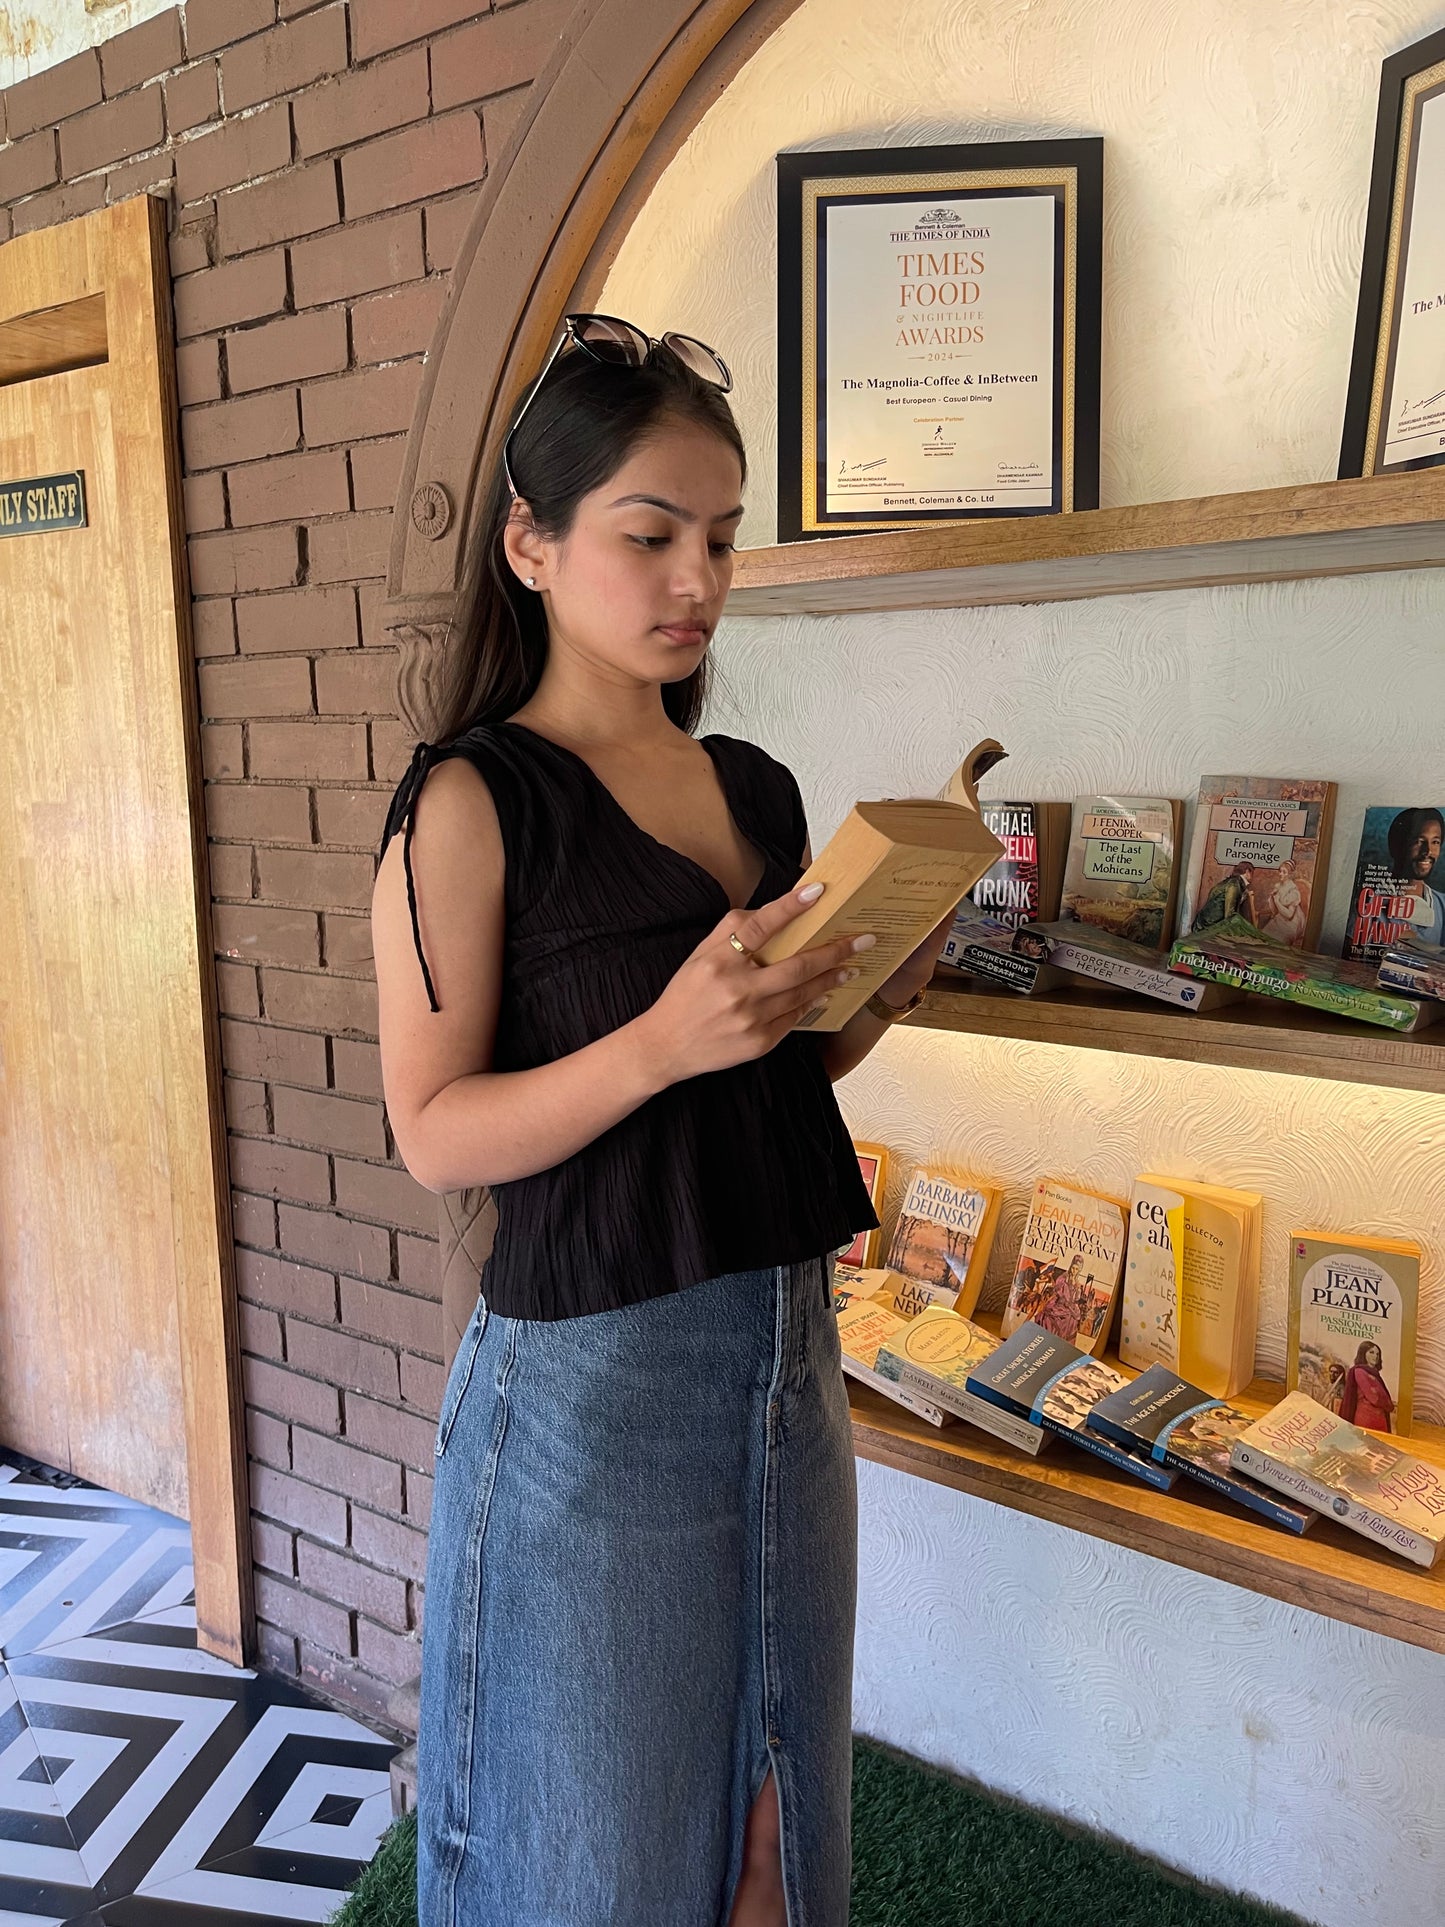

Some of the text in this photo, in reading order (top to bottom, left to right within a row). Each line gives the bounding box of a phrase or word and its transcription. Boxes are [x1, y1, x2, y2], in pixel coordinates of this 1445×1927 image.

[890, 229, 990, 242] THE TIMES OF INDIA
[897, 251, 985, 277] TIMES
[900, 282, 980, 307] FOOD
[912, 312, 985, 323] NIGHTLIFE
[1412, 301, 1433, 315] The
[895, 326, 985, 347] AWARDS
[928, 353, 953, 361] 2024
[841, 373, 1039, 391] The Magnolia-Coffee & InBetween
[902, 397, 937, 405] European
[943, 395, 969, 403] Casual
[969, 394, 993, 403] Dining
[26, 483, 77, 522] STAFF
[883, 497, 917, 505] Bennett,
[919, 496, 955, 504] Coleman
[965, 495, 979, 503] Co.
[1226, 799, 1268, 807] WORDSWORTH
[1229, 819, 1287, 832] TROLLOPE
[1230, 808, 1290, 822] ANTHONY
[1101, 827, 1143, 838] COOPER
[1099, 842, 1142, 854] The Last
[1225, 848, 1280, 864] Parsonage
[1233, 838, 1276, 852] Framley
[1092, 863, 1143, 876] Mohicans
[1105, 854, 1132, 864] of the
[973, 878, 1031, 909] TRUNK
[1357, 887, 1415, 919] GIFTED
[970, 947, 1029, 974] CONNECTIONS
[1066, 949, 1131, 976] GEORGETTE
[1351, 946, 1363, 955] The
[1364, 947, 1378, 957] Ben
[987, 963, 1015, 979] DEATH
[1076, 961, 1113, 979] HEYER
[1178, 953, 1290, 993] michael morpurgo
[916, 1180, 976, 1212] BARBARA
[1045, 1190, 1056, 1198] Pan
[908, 1195, 977, 1230] DELINSKY
[1033, 1203, 1071, 1224] JEAN
[1073, 1213, 1121, 1240] PLAIDY
[1025, 1236, 1067, 1258] QUEEN
[1027, 1224, 1119, 1263] EXTRAVAGANT
[1148, 1225, 1173, 1252] ah
[901, 1283, 934, 1305] LAKE
[1325, 1270, 1381, 1296] JEAN
[1311, 1287, 1393, 1319] PLAIDY
[1320, 1315, 1382, 1334] PASSIONATE
[1340, 1311, 1362, 1322] THE
[1327, 1325, 1375, 1340] ENEMIES
[991, 1335, 1045, 1384] GREAT SHORT STORIES
[1010, 1346, 1056, 1389] AMERICAN WOMEN
[903, 1371, 935, 1391] GASKELL
[1123, 1383, 1188, 1427] THE AGE OF INNOCENCE
[1042, 1420, 1057, 1430] GREAT
[1097, 1447, 1122, 1463] AMERICAN
[1258, 1410, 1312, 1452] SHIRLEE
[1289, 1417, 1338, 1455] BUSBEE
[1166, 1455, 1232, 1493] THE AGE OF INNOCENCE
[1255, 1459, 1331, 1504] SHIRLEE BUSBEE
[1378, 1464, 1439, 1511] At Long
[1413, 1484, 1445, 1517] Last
[1276, 1511, 1293, 1523] DOVER
[1350, 1510, 1418, 1550] At Long Last
